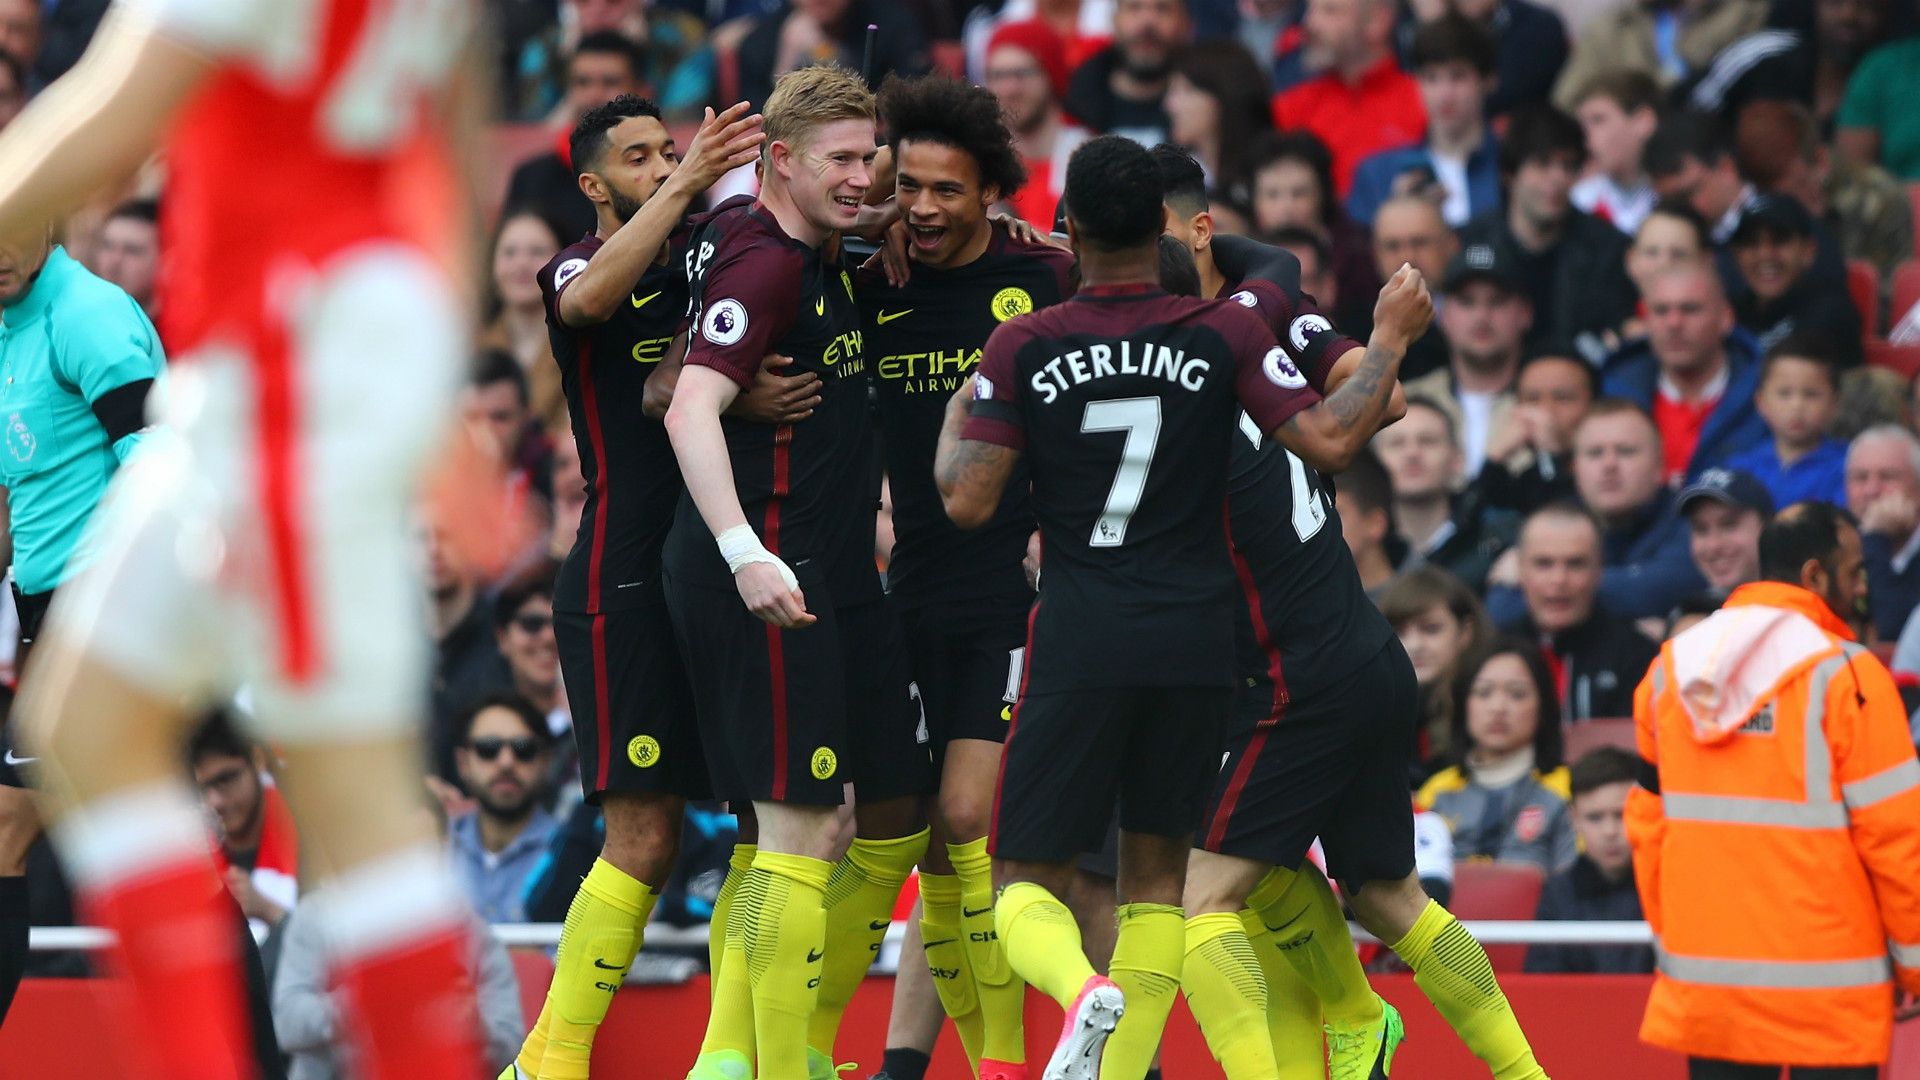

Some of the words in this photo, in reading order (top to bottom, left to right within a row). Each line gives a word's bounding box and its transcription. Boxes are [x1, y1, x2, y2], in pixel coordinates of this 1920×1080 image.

[878, 348, 983, 379] ETIHA
[905, 375, 970, 394] AIRW
[1031, 340, 1210, 404] STERLING
[1080, 396, 1163, 547] 7
